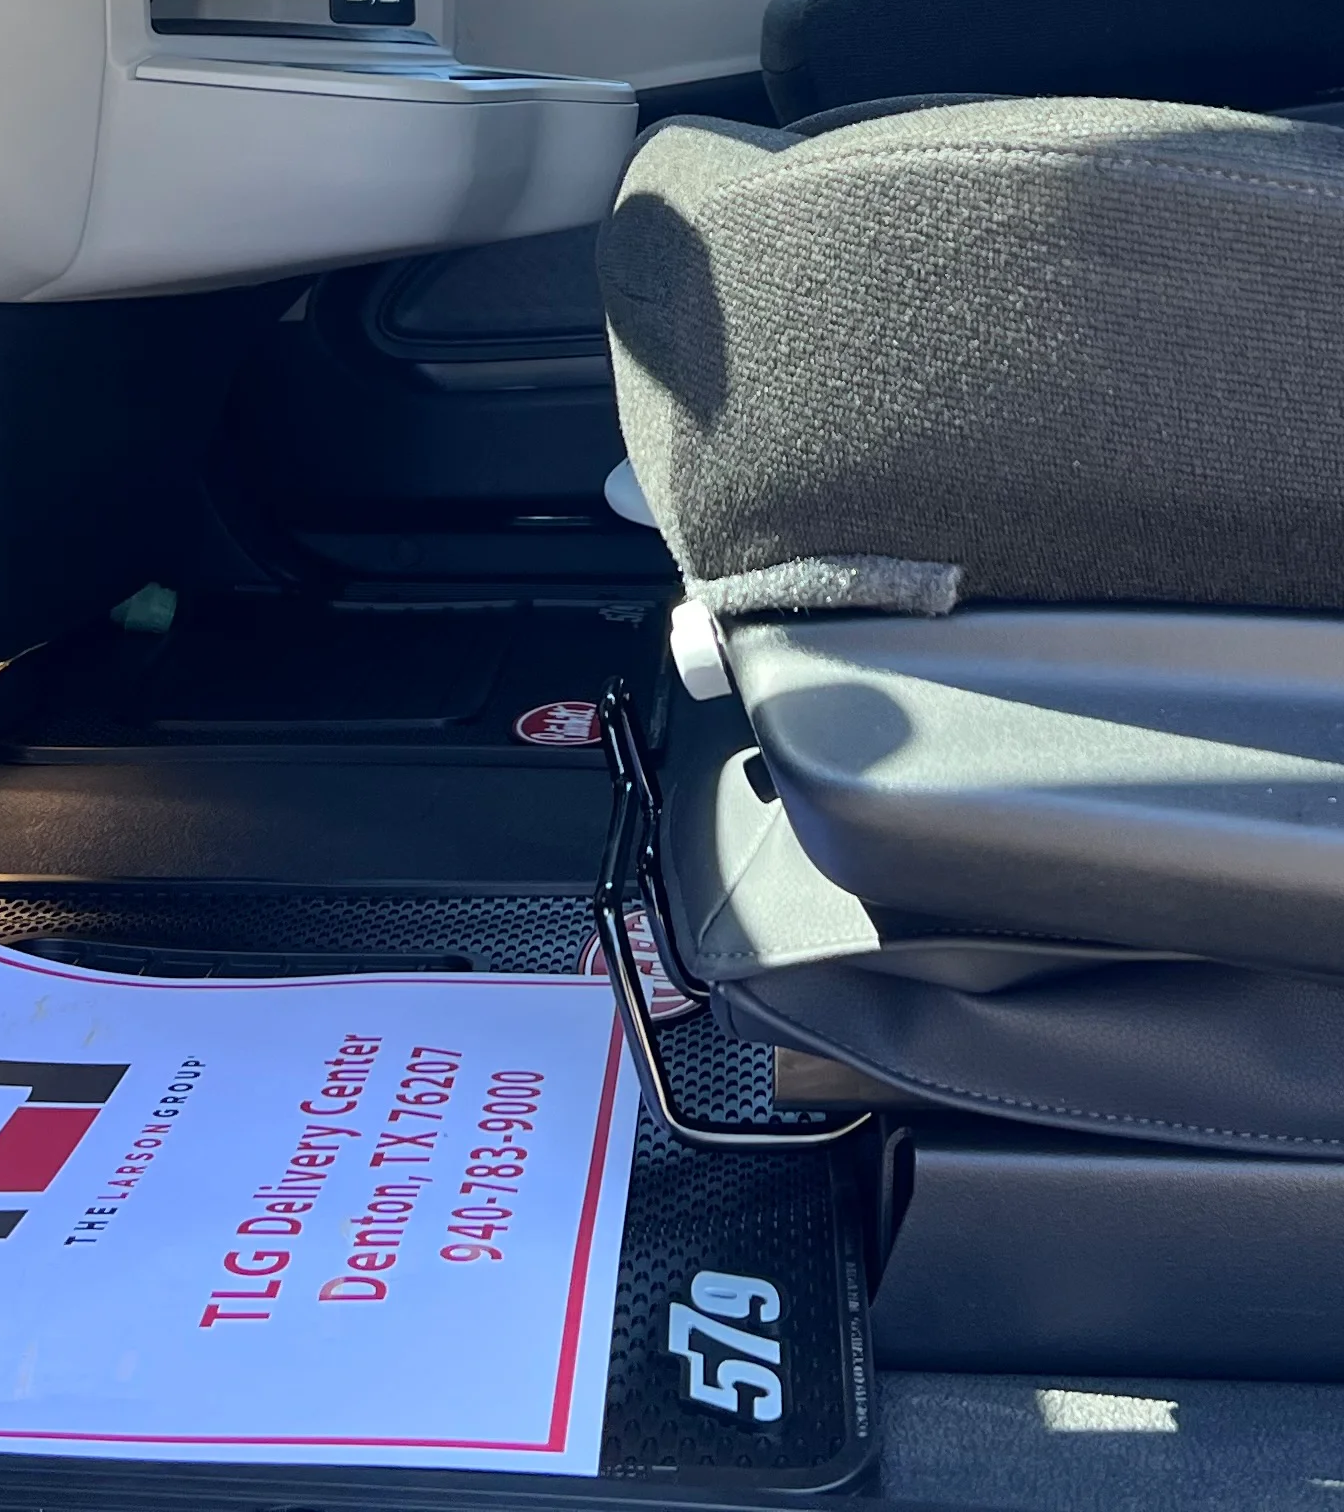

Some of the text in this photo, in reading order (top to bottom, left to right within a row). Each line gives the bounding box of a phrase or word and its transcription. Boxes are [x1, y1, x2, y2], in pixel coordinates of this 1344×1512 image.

[64, 1058, 207, 1246] THE LARSON GROUP
[199, 1033, 383, 1328] TLG Delivery Center
[318, 1046, 463, 1302] Denton, TX 76207
[439, 1070, 545, 1263] 940-783-9000
[668, 1270, 783, 1423] 579
